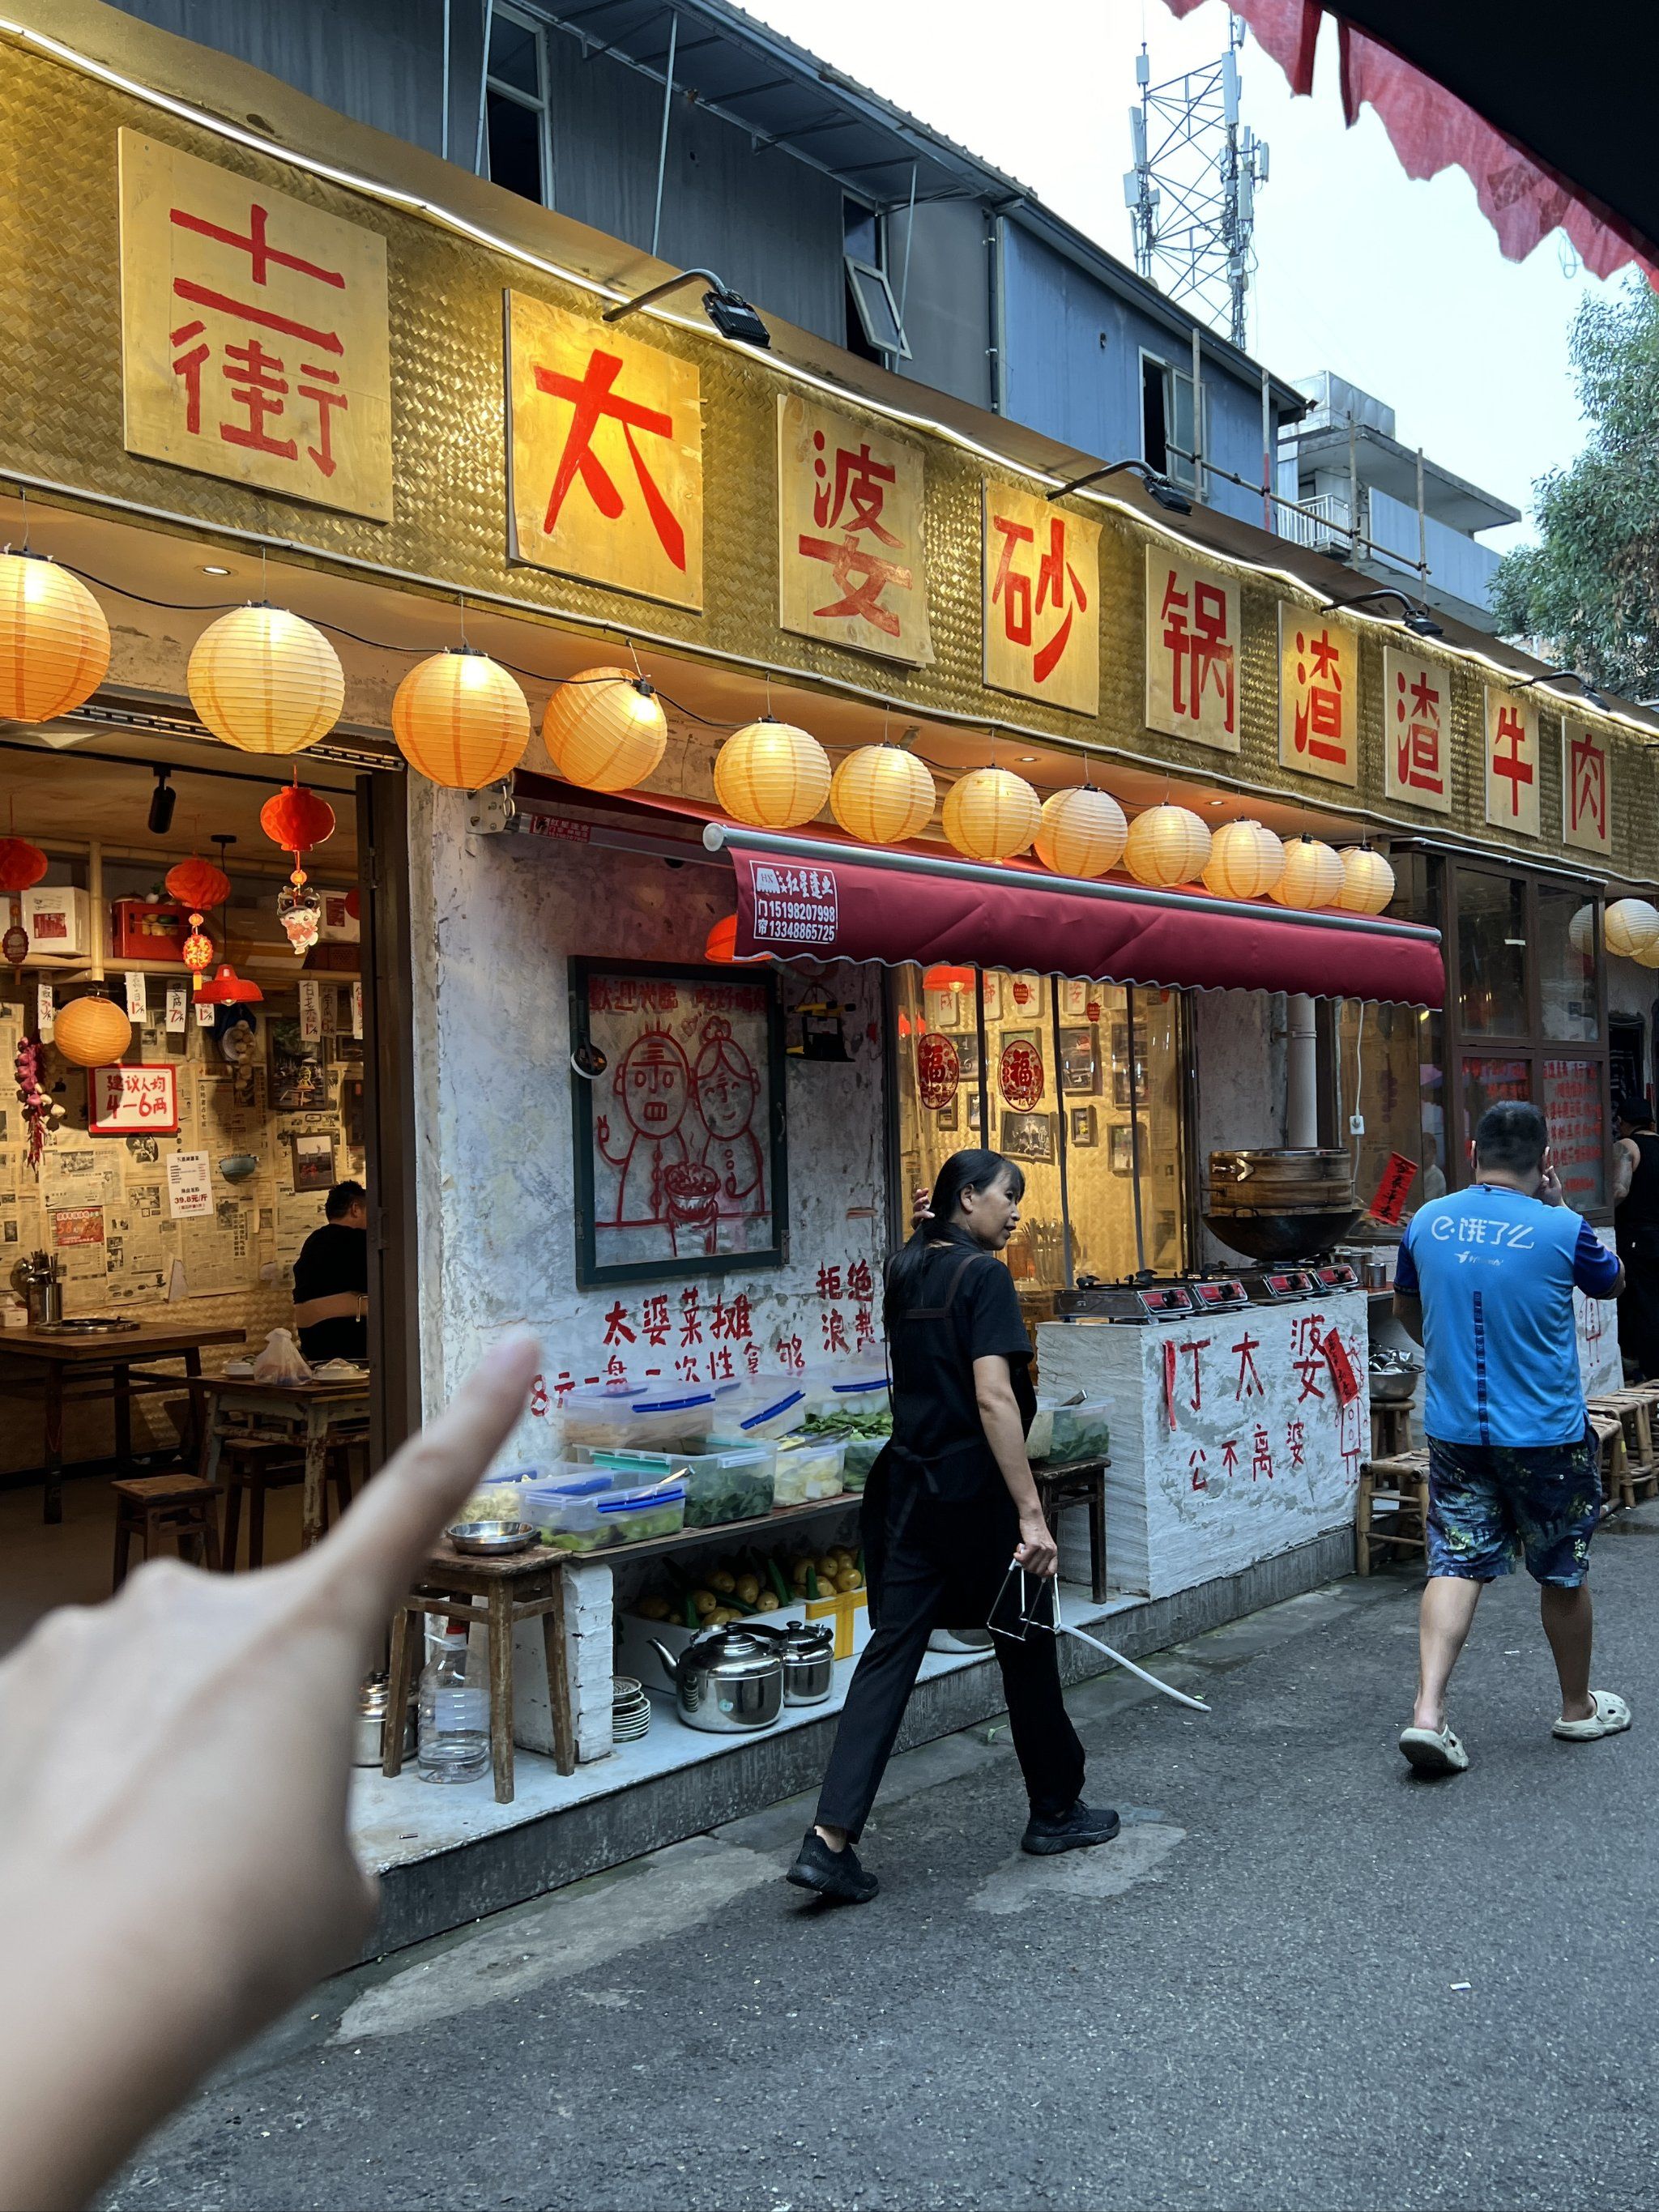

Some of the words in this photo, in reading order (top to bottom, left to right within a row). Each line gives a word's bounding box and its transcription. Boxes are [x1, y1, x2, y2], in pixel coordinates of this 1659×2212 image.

[770, 901, 835, 922] 15198207998
[770, 920, 835, 942] 13348865725
[107, 1075, 166, 1093] 建议人均
[815, 1258, 874, 1303] 拒绝
[603, 1286, 753, 1349] 太婆菜摊
